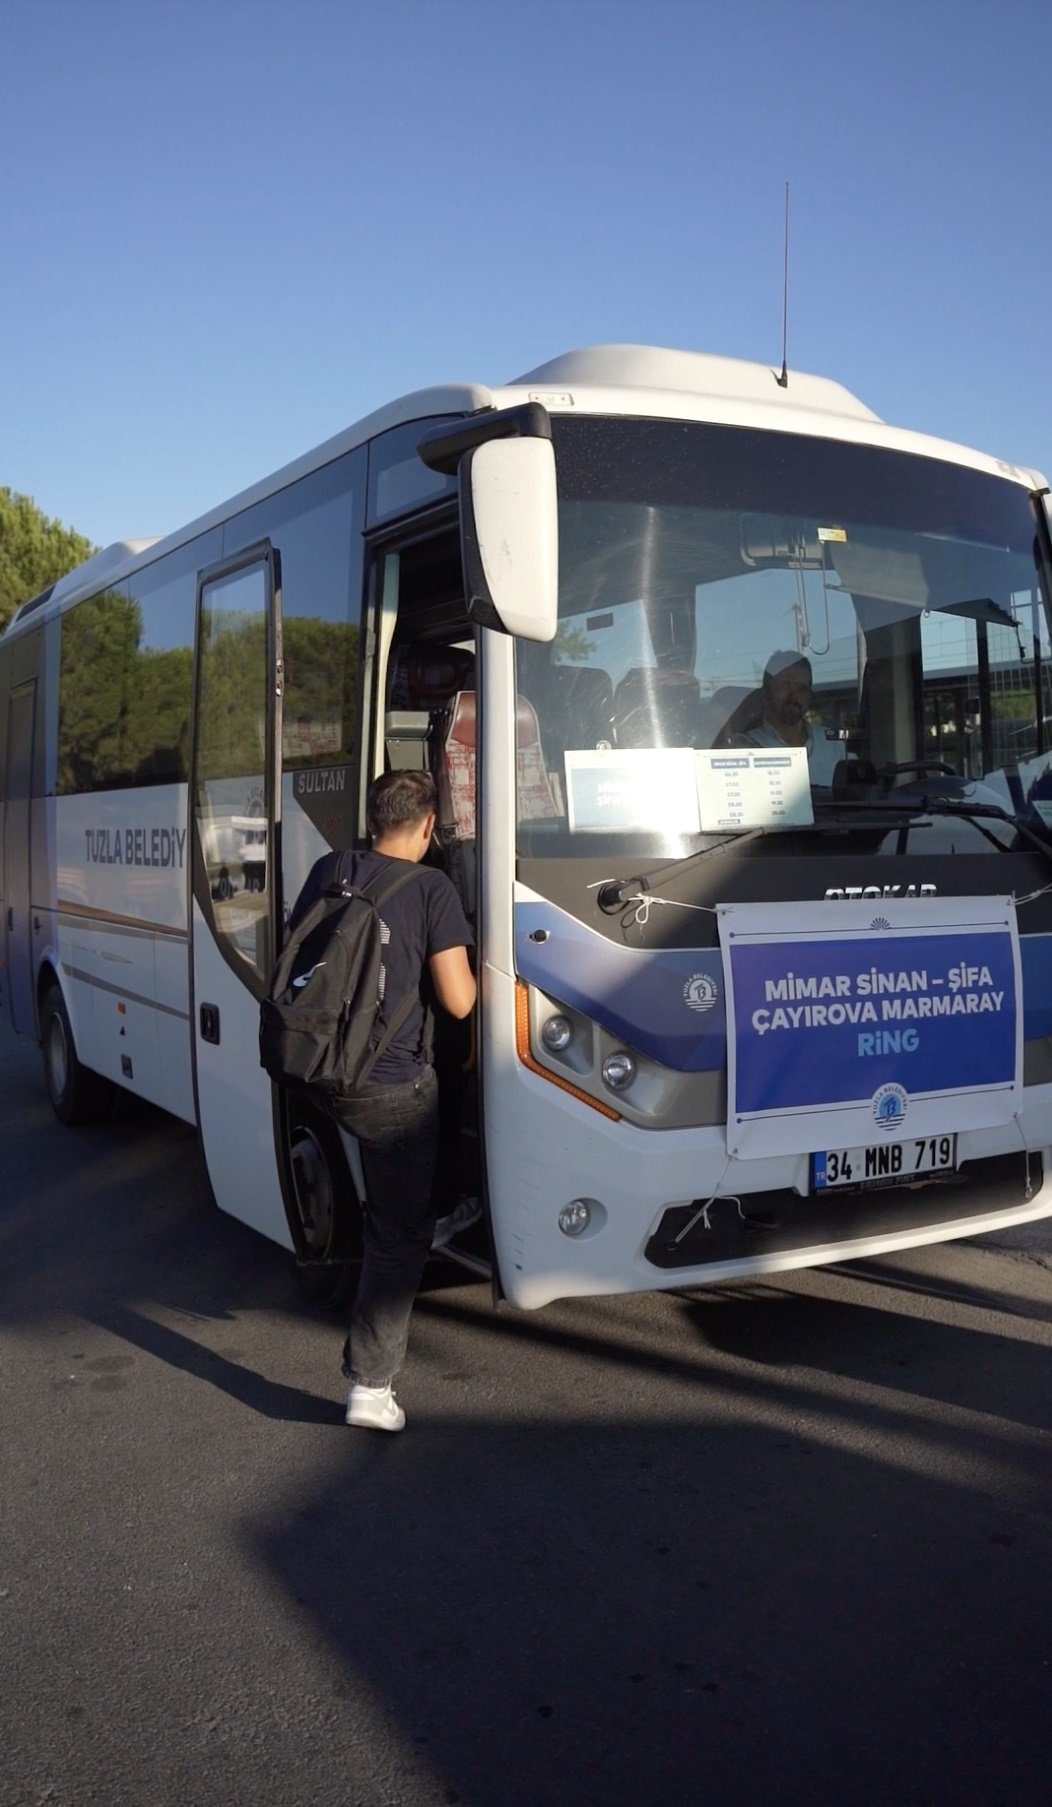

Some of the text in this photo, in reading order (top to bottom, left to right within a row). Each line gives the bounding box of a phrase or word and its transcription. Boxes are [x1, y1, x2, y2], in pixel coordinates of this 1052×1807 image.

[298, 769, 346, 793] SULTAN
[85, 829, 123, 864] TUZLA
[765, 972, 851, 1001] MİMAR
[856, 967, 928, 996] SİNAN
[948, 961, 994, 992] ŞİFA
[752, 991, 1004, 1035] ÇAYIROVA MARMARAY
[816, 1171, 827, 1181] TR
[827, 1152, 852, 1183] 34
[865, 1144, 902, 1178] MNB
[915, 1137, 951, 1170] 719
